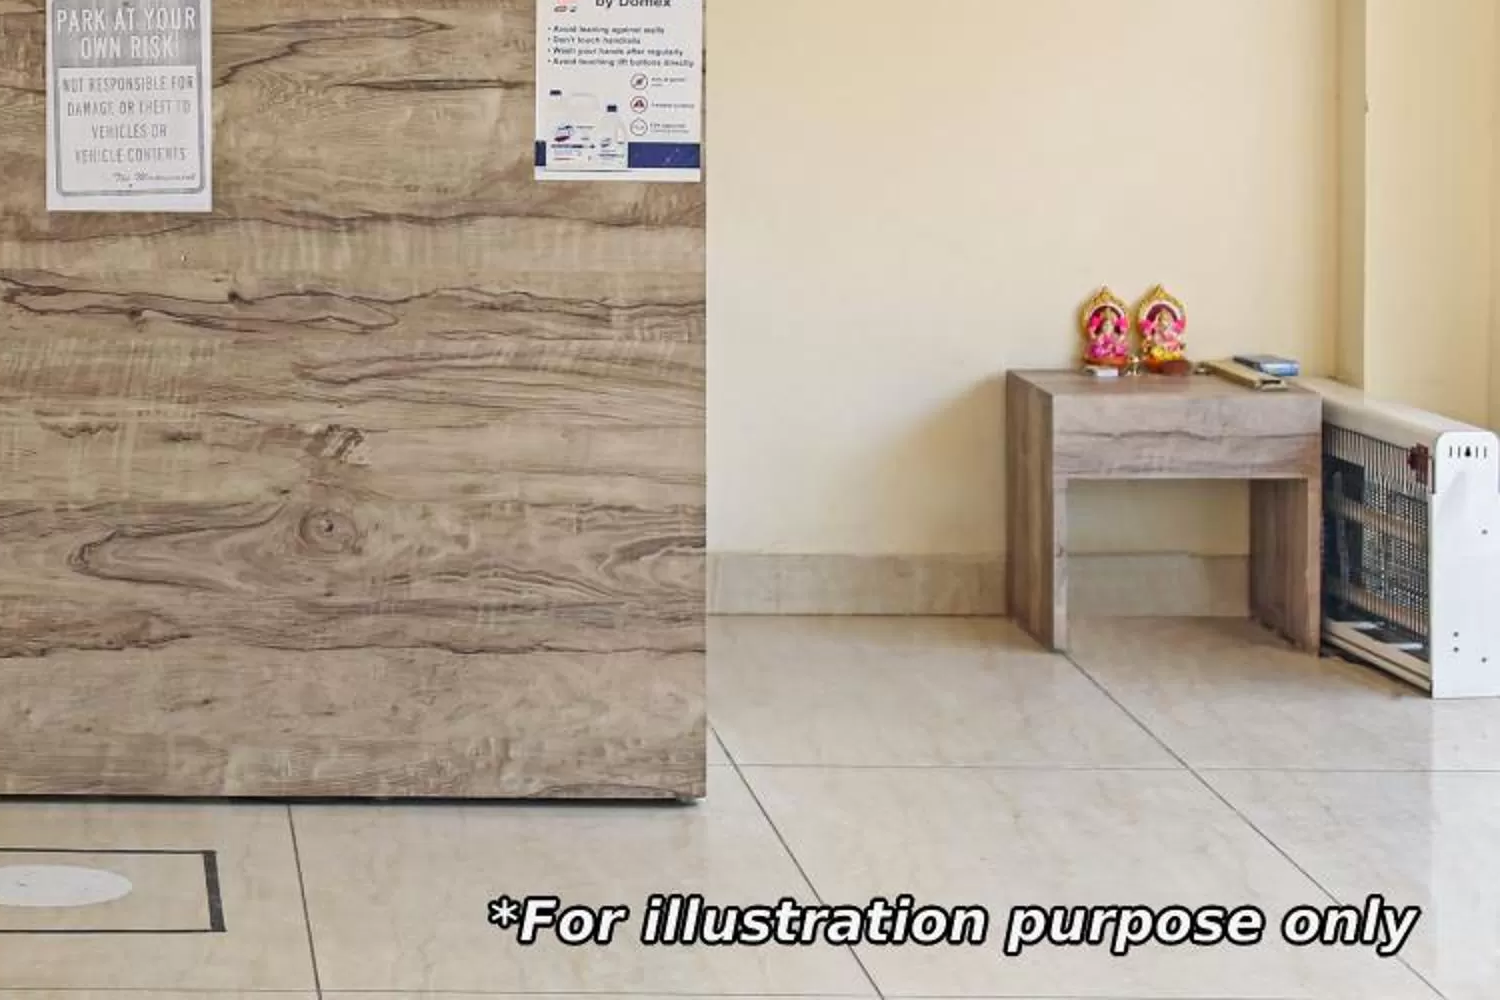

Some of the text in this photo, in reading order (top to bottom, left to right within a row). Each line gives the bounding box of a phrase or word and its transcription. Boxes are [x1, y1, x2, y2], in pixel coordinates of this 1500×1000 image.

[56, 7, 196, 33] PARK AT YOUR
[81, 36, 121, 60] OWN
[63, 75, 193, 93] NOT RESPONSIBLE FOR
[68, 99, 192, 117] DAMAGE OR THEFT TO
[91, 123, 167, 139] VEHICLES OR
[75, 147, 187, 165] VEHICLE CONTENTS
